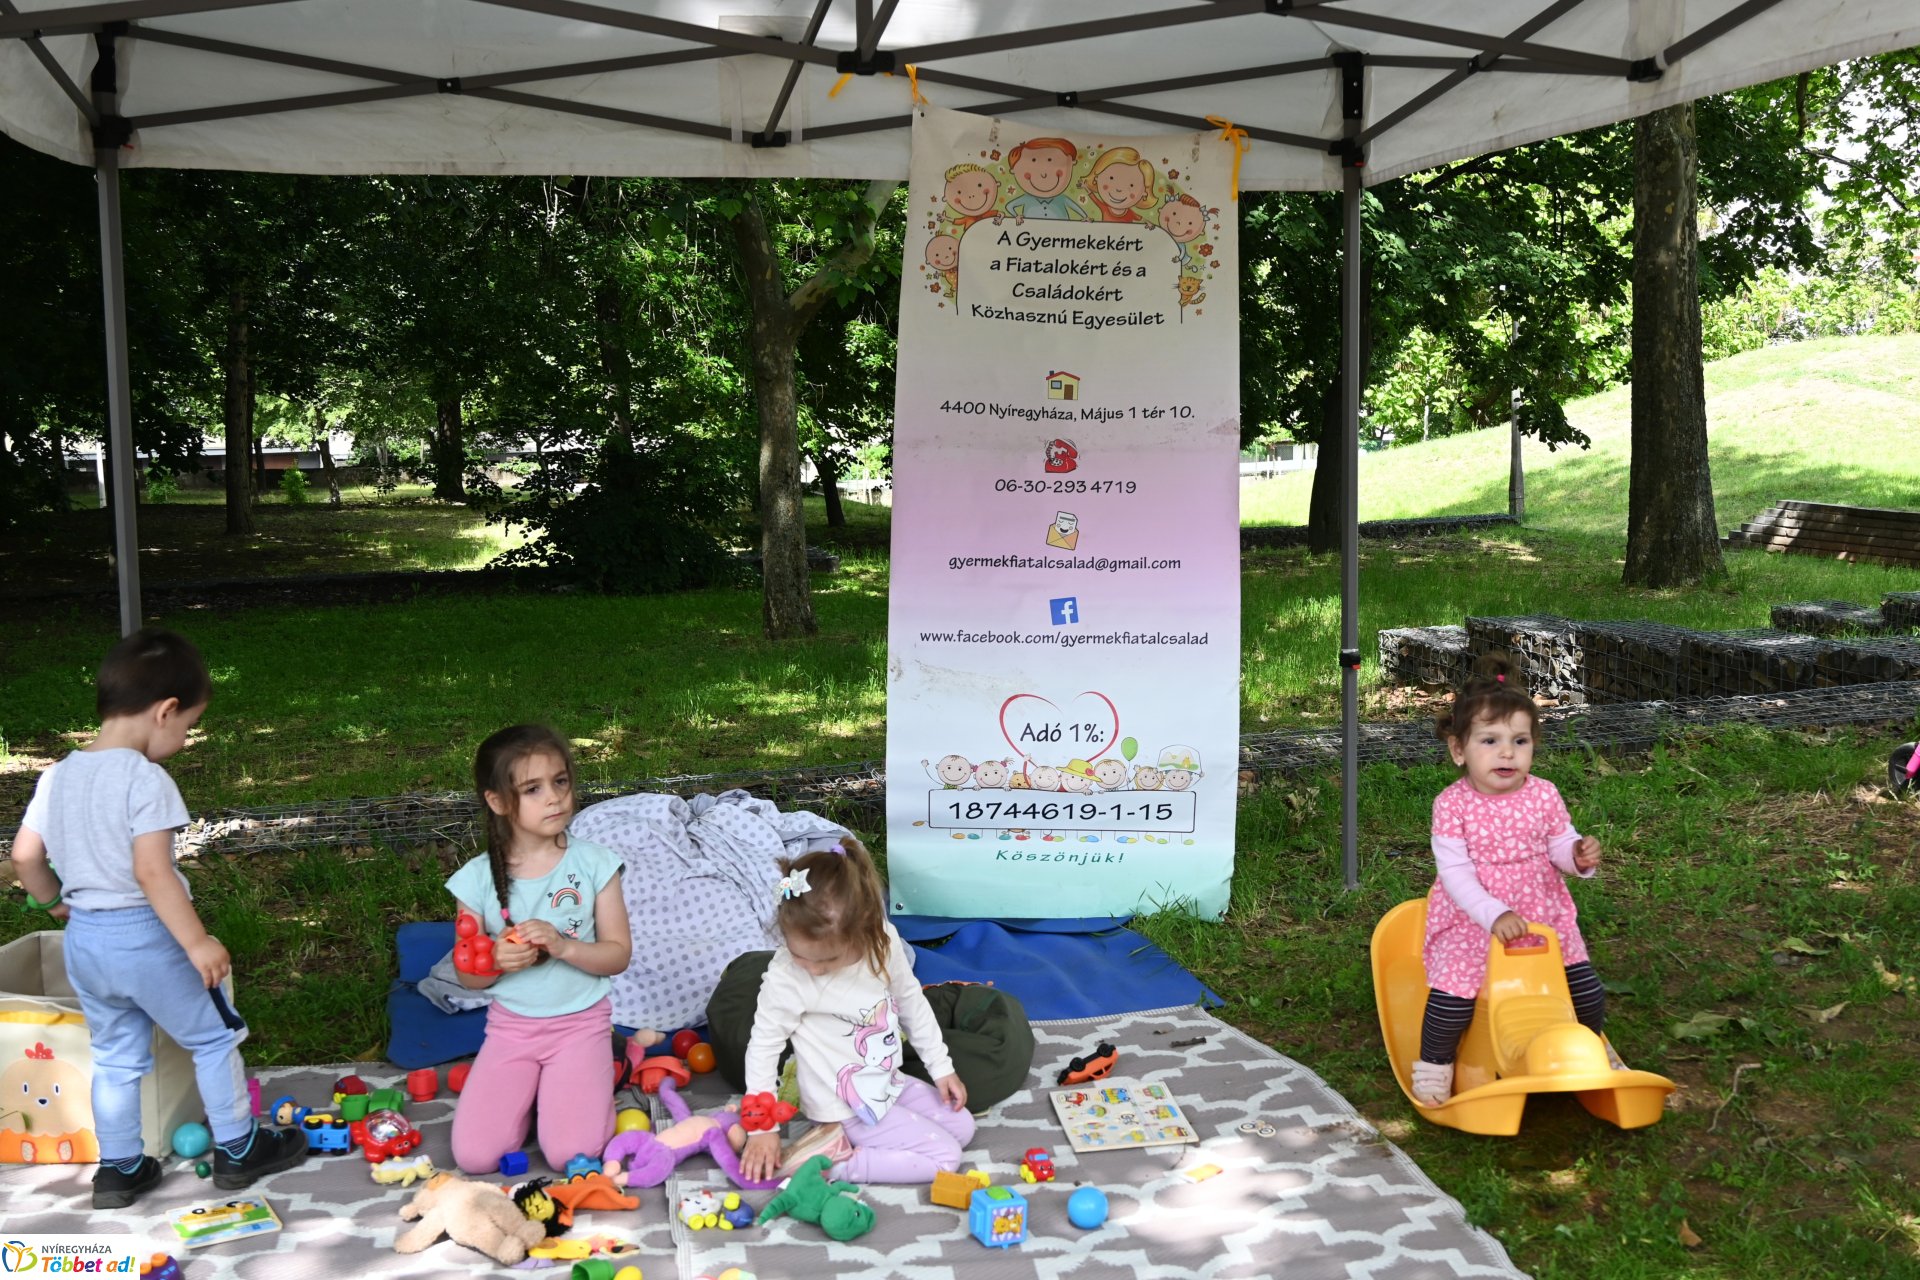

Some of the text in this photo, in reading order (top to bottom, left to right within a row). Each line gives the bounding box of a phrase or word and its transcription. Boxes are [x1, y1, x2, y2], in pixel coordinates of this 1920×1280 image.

[996, 230, 1144, 252] A Gyermekekért
[989, 256, 1147, 278] a Fiatalokért és a
[1011, 282, 1124, 302] Családokért
[971, 303, 1166, 331] Közhasznú Egyesület
[939, 399, 1196, 424] 4400 Nyíregyháza, Május 1 tér 10.
[994, 478, 1138, 495] 06-30-293 4719
[948, 554, 1181, 573] gyermekfiatalcsalad@gmail.com
[919, 629, 1209, 648] www.facebook.com/gyermekfiatalcsalad
[1019, 722, 1105, 743] Adó 1%:
[948, 801, 1173, 821] 18744619-1-15
[995, 849, 1125, 866] Köszönjük!
